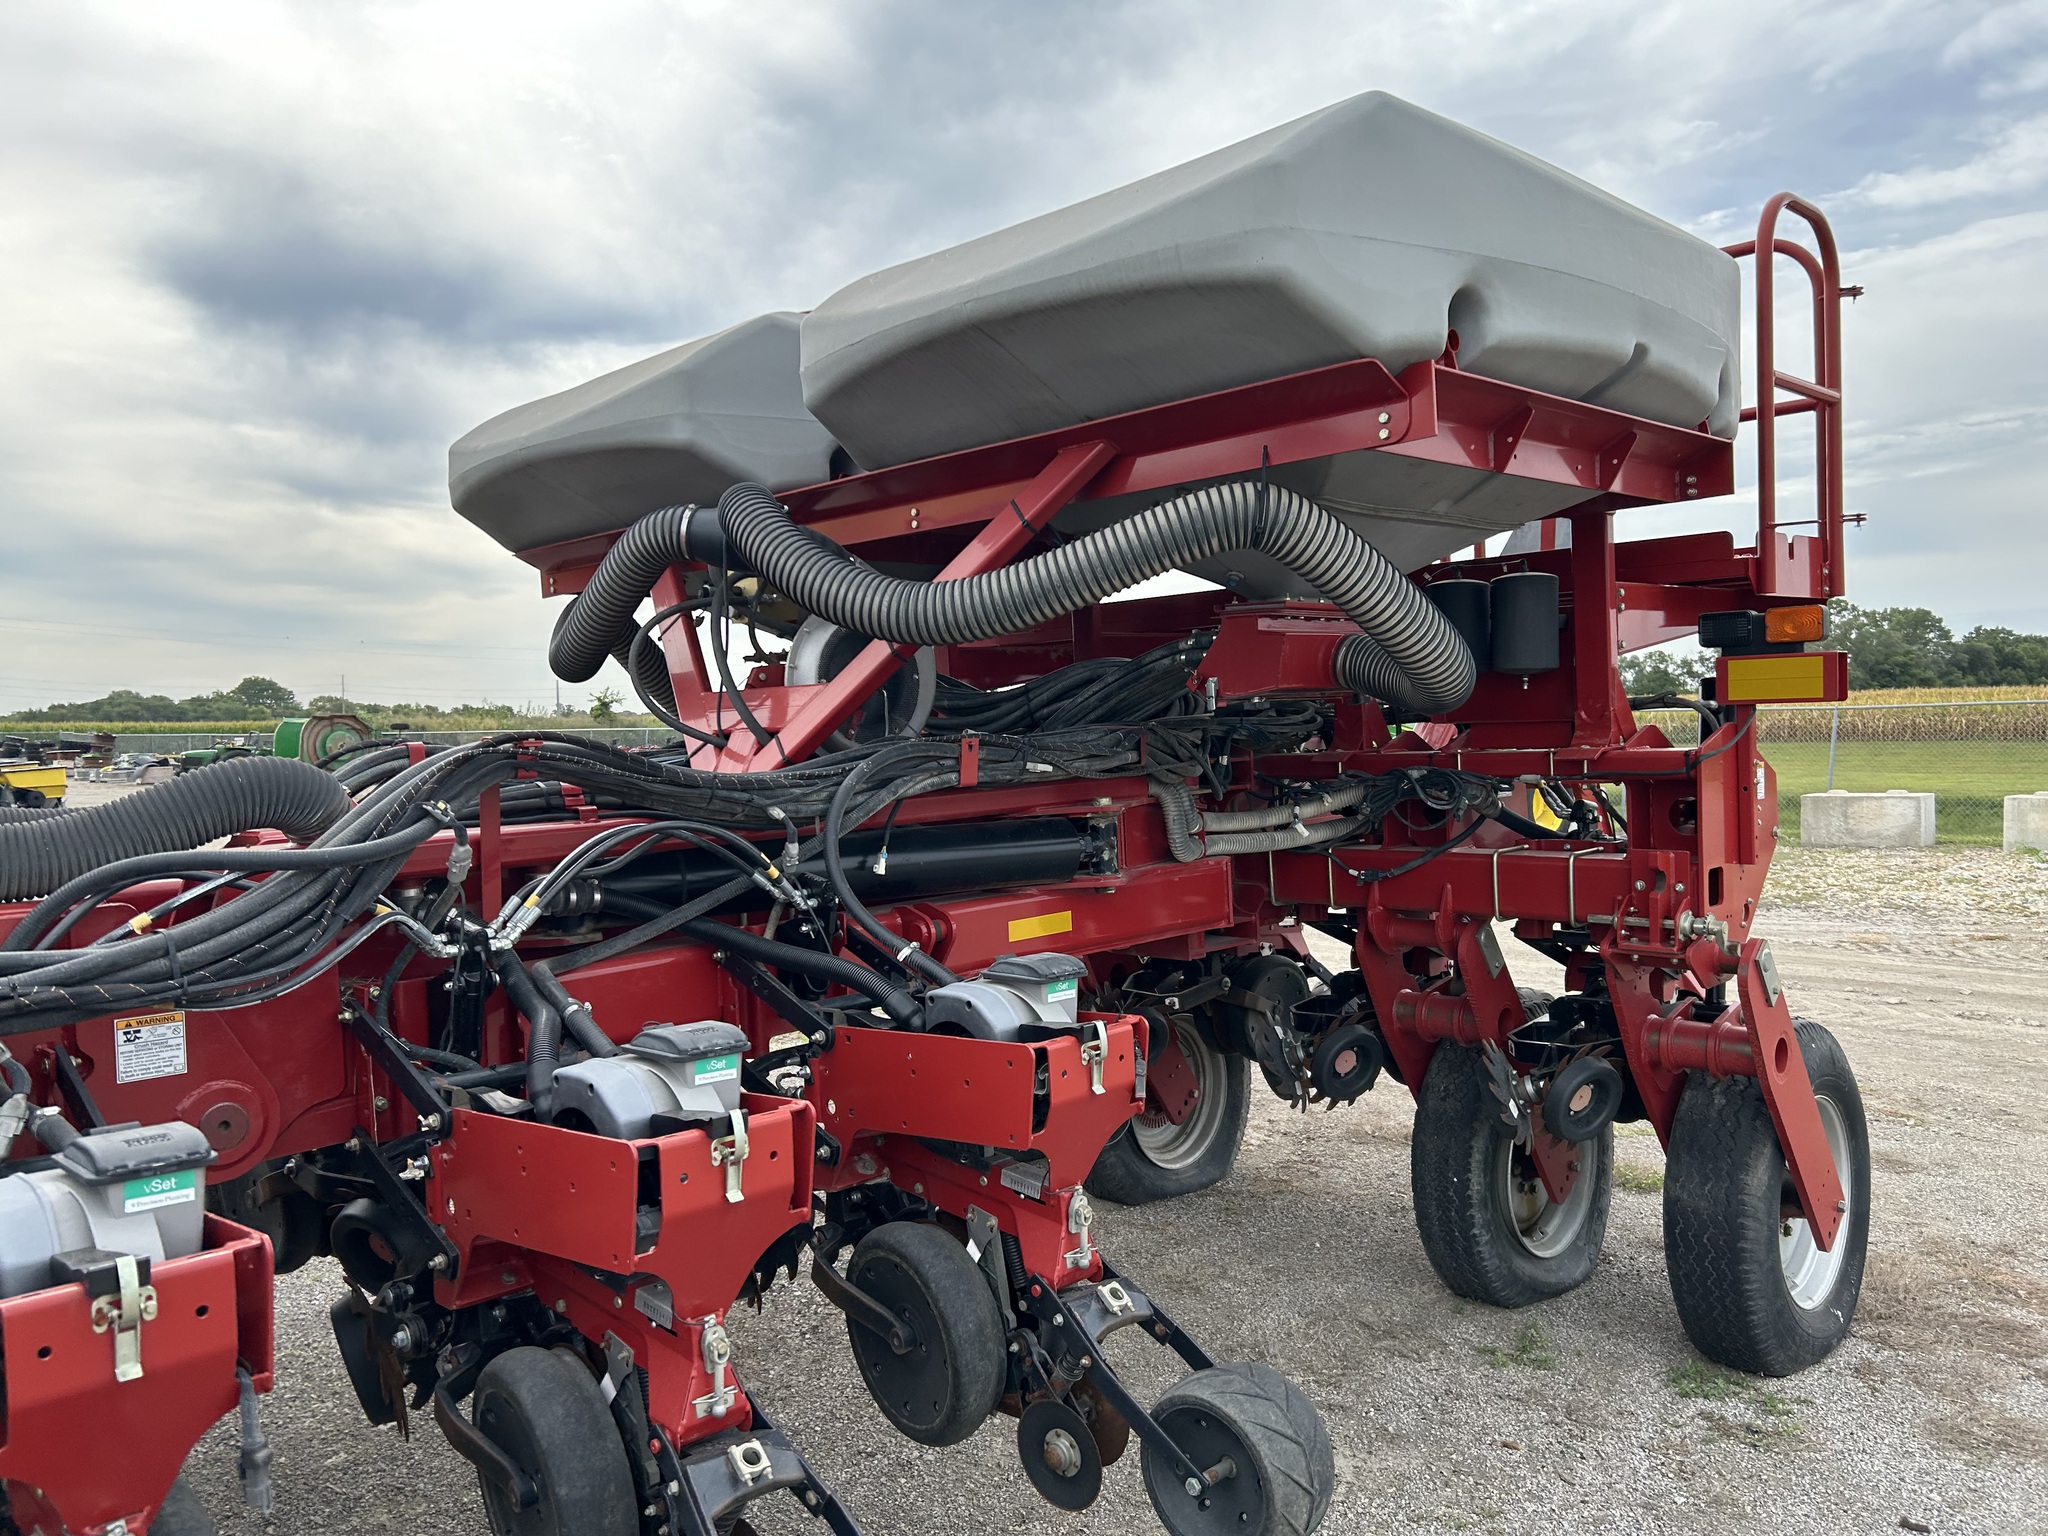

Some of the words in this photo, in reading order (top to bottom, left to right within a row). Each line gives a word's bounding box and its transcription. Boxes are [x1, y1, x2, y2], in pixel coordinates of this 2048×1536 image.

[1055, 982, 1069, 991] vSet
[136, 1015, 176, 1026] WARNING
[706, 1059, 727, 1070] vSet
[143, 1177, 178, 1193] vSet
